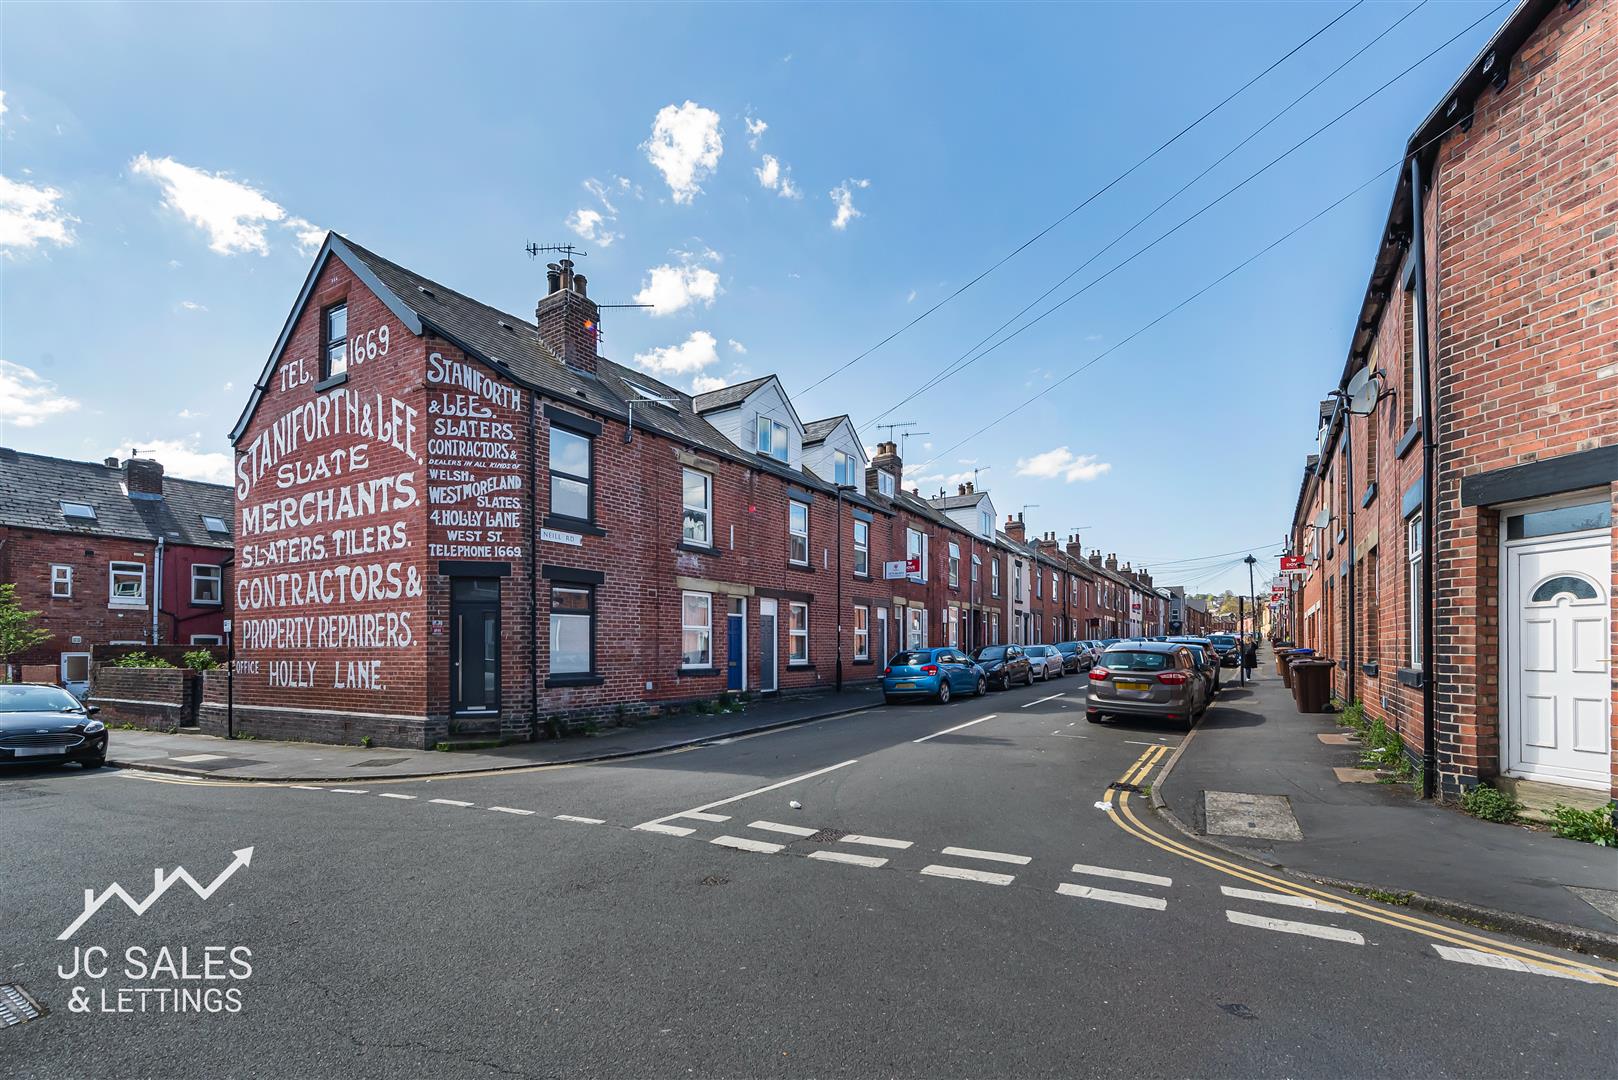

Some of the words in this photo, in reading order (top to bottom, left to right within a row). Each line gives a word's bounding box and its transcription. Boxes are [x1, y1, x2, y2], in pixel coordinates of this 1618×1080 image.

[280, 359, 313, 391] TEL.
[350, 325, 390, 366] 1669
[434, 418, 516, 440] SLATERS.
[276, 444, 369, 488] SLATE
[242, 472, 421, 536] MERCHANTS.
[428, 475, 522, 504] WESTMORELAND
[485, 511, 521, 528] LANE
[241, 534, 329, 568] SLATERS.
[332, 521, 412, 557] TILERS.
[428, 544, 491, 557] TELEPHONE
[447, 530, 482, 542] WEST
[486, 531, 505, 542] ST.
[543, 531, 562, 540] NEILL
[242, 617, 315, 649] PROPERTY
[318, 611, 417, 648] REPAIRERS.
[236, 660, 260, 675] OFFICE
[269, 660, 317, 688] HOLLY
[334, 659, 387, 690] LANE.
